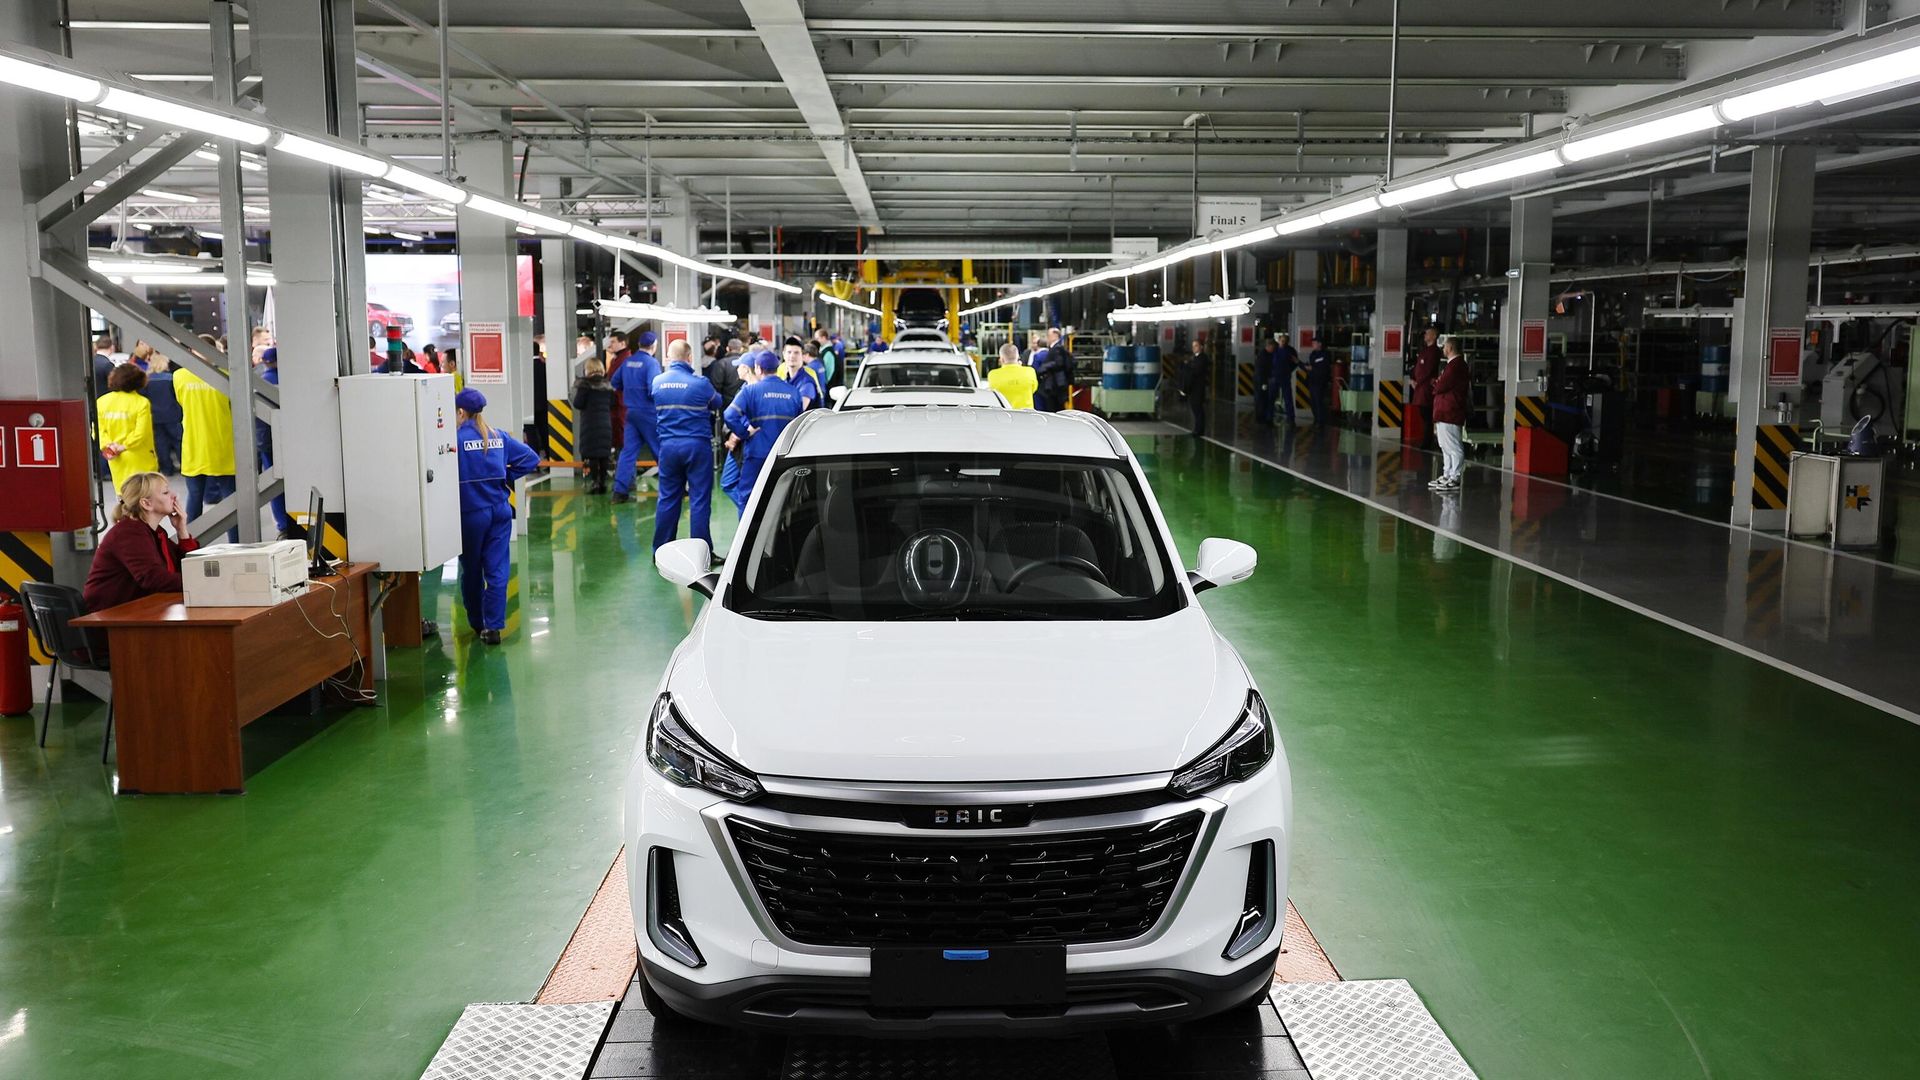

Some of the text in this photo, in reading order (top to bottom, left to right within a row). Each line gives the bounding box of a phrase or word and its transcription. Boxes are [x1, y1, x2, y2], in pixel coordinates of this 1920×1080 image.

[1210, 215, 1246, 226] Final 5
[659, 382, 688, 390] АВТОТОР
[763, 392, 792, 400] АВТОТОР
[935, 809, 1002, 824] BAIC
